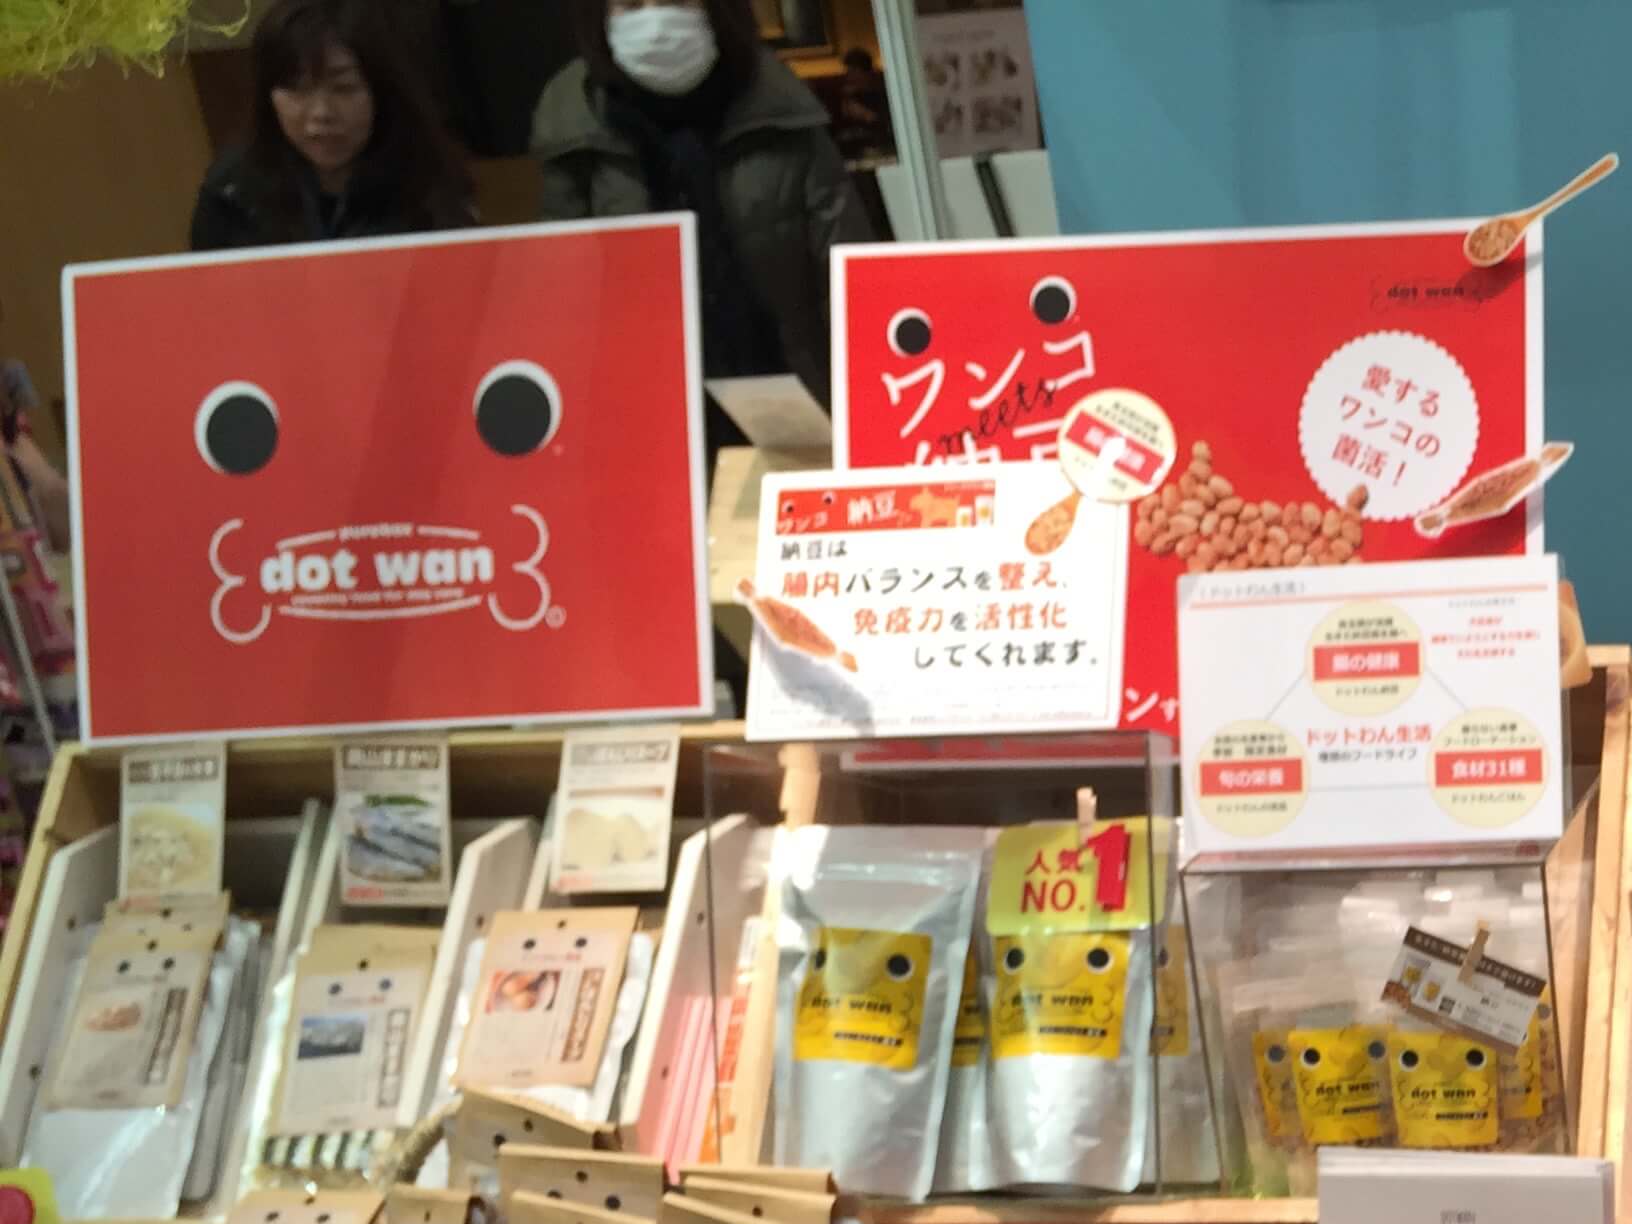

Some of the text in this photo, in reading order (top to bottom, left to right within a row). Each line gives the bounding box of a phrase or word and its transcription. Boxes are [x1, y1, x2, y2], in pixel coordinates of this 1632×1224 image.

[882, 332, 1095, 437] ワンコ
[1362, 364, 1442, 417] 愛する
[1340, 395, 1441, 457] ワンコの
[780, 540, 848, 561] 納豆は
[261, 546, 494, 592] dot wan
[853, 602, 1068, 635] 免疫力を活性化
[913, 640, 1098, 669] してくれます。
[1306, 723, 1432, 747] ドットわん生活
[1026, 848, 1083, 875] 人気
